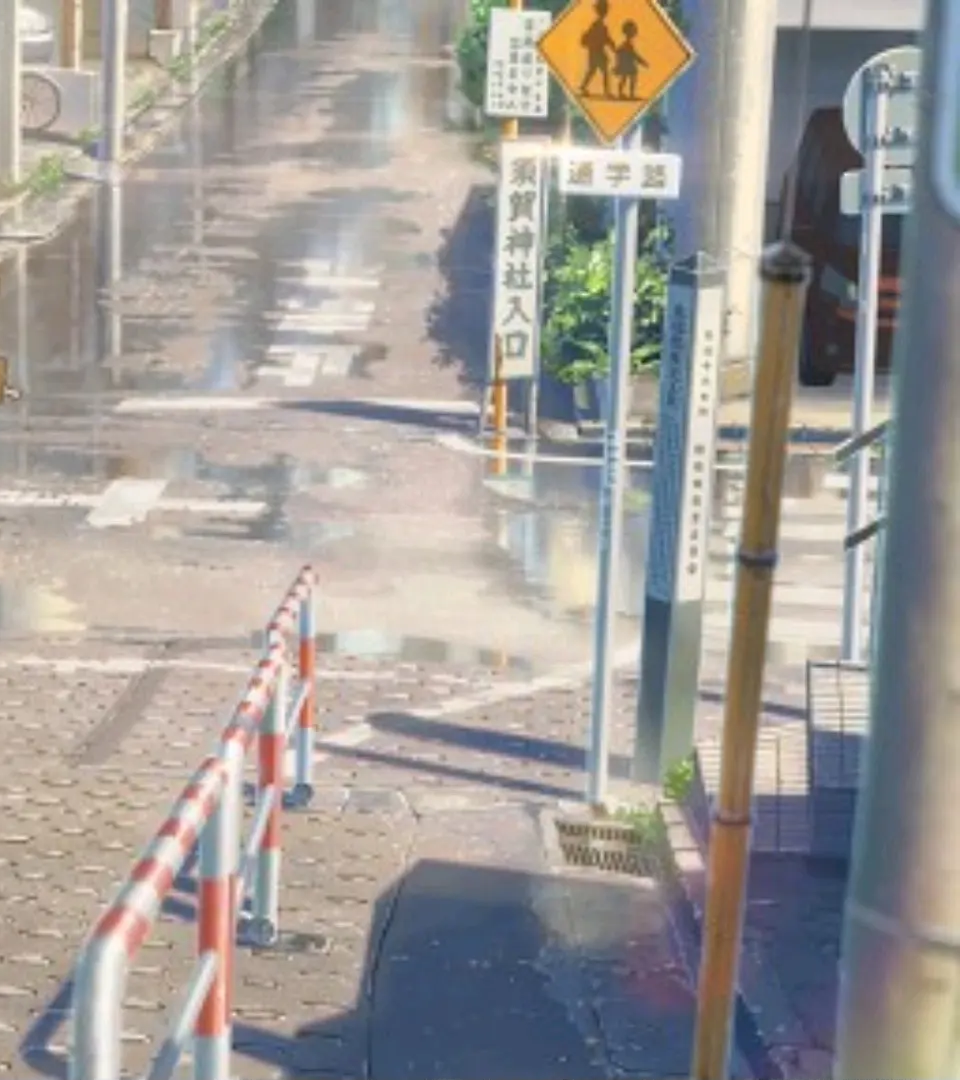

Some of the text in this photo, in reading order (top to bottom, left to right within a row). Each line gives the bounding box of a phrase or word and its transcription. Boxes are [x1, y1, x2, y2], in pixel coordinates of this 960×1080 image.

[501, 155, 537, 359] 須賀神社入口
